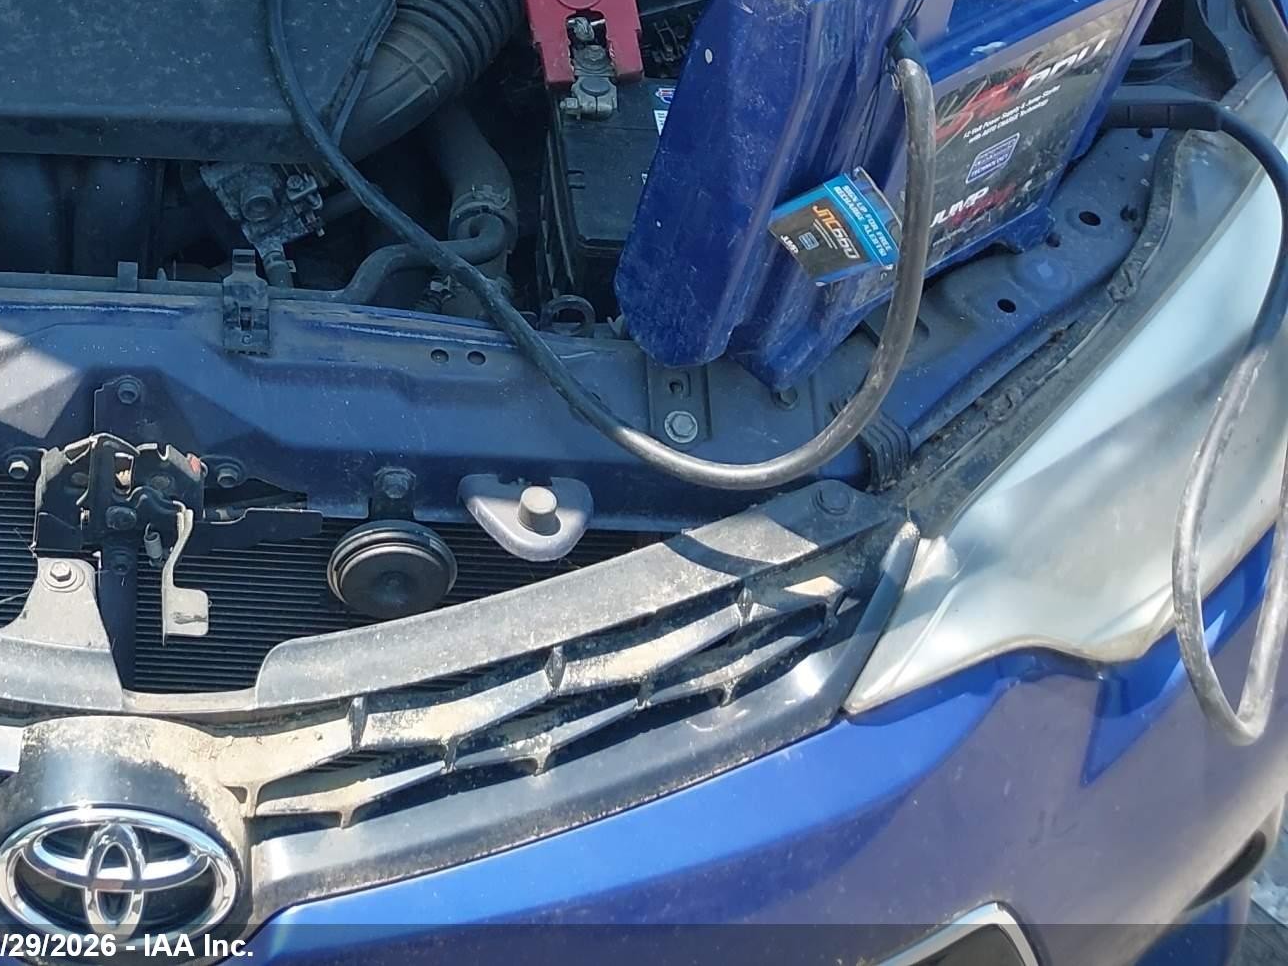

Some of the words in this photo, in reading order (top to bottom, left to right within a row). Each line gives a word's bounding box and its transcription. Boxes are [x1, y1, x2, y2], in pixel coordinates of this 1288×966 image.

[833, 186, 864, 221] RECHARGE
[855, 202, 868, 213] UP
[865, 214, 879, 231] FOR
[875, 231, 894, 252] FREE
[812, 207, 861, 258] JNC660
